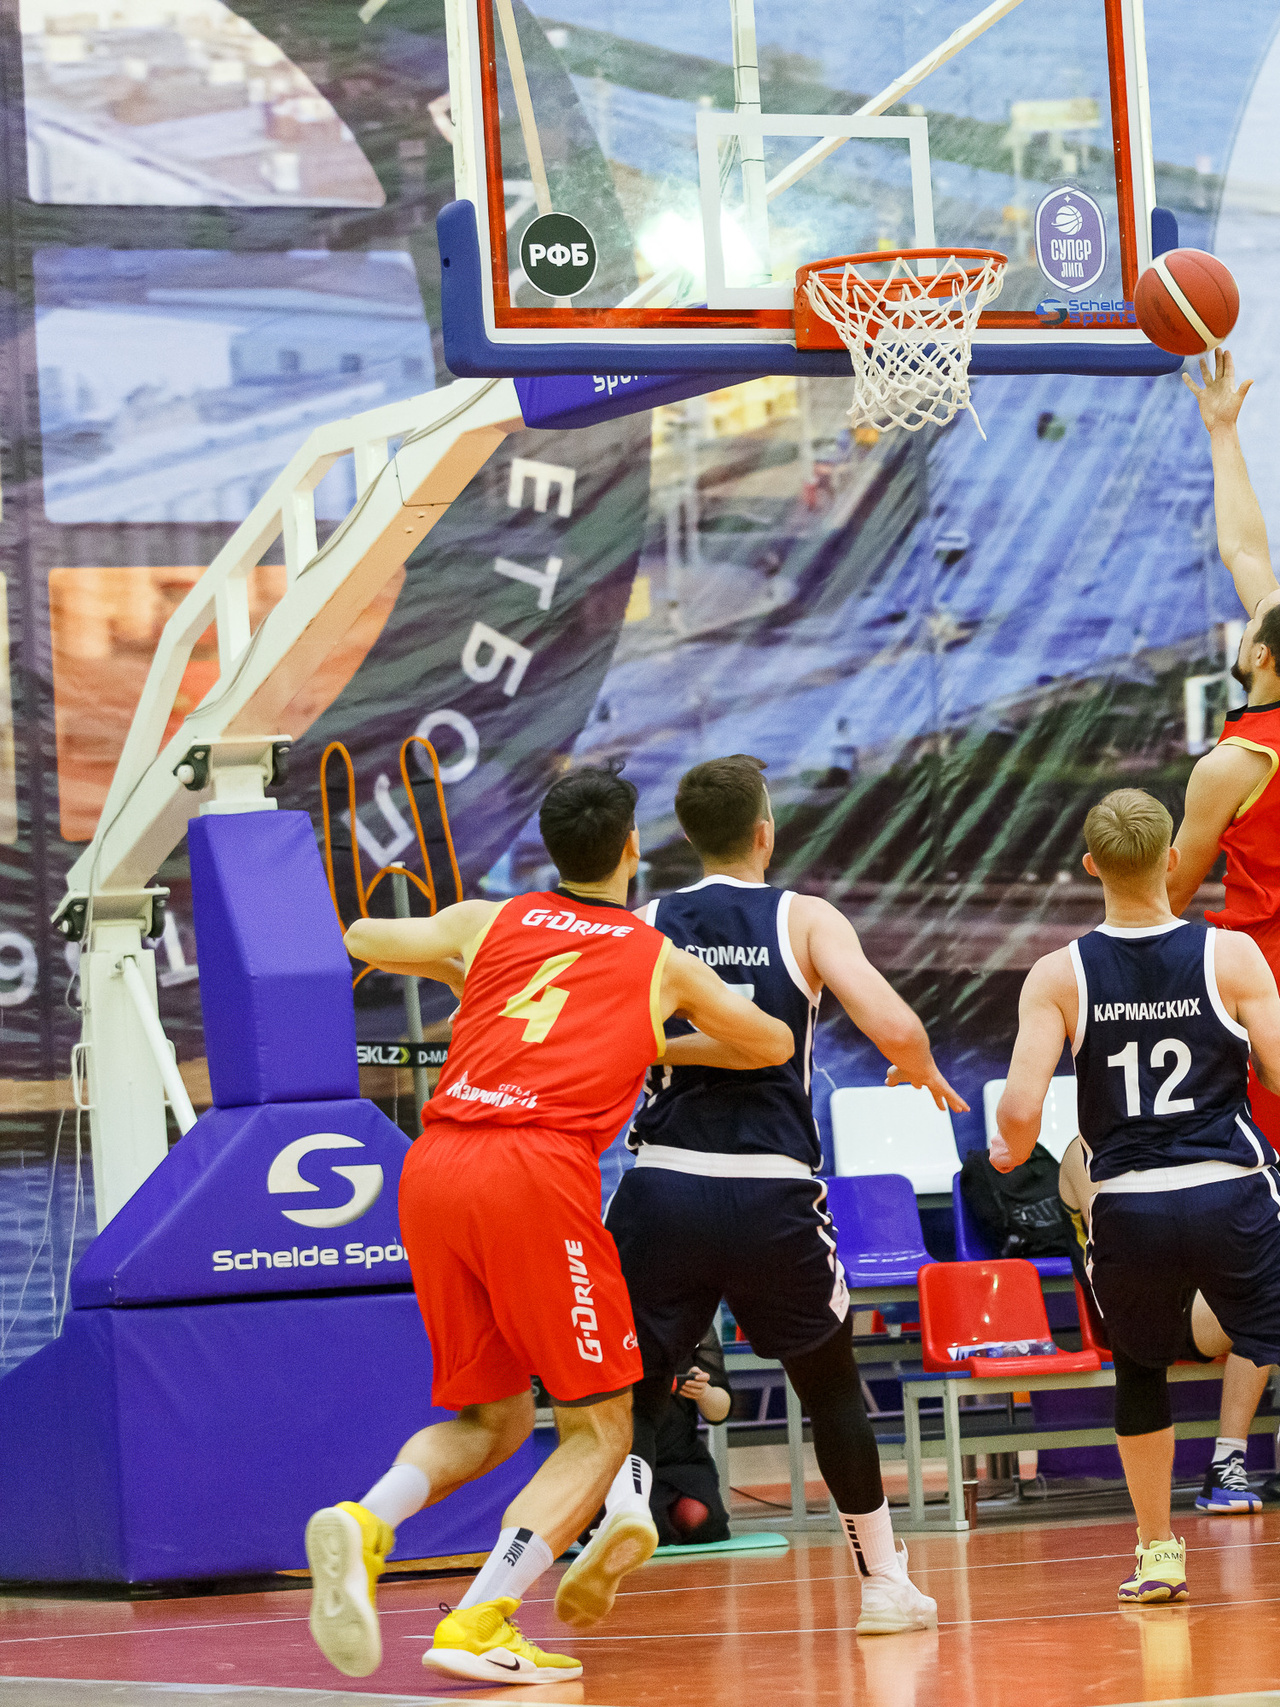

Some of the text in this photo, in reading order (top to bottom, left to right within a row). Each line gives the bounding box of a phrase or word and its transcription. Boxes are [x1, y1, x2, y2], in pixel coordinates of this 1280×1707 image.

[529, 242, 589, 267] РФБ
[1051, 239, 1092, 261] СУПЕР
[1061, 262, 1084, 278] ЛИГА
[1069, 300, 1135, 311] Schelde
[1069, 311, 1137, 327] Sports
[498, 951, 583, 1044] 4
[1094, 998, 1201, 1022] КАРМАКСКИХ
[356, 1045, 400, 1065] SKLZ
[1107, 1038, 1195, 1117] 12
[213, 1246, 340, 1271] Schelde
[503, 1540, 526, 1567] NIKE
